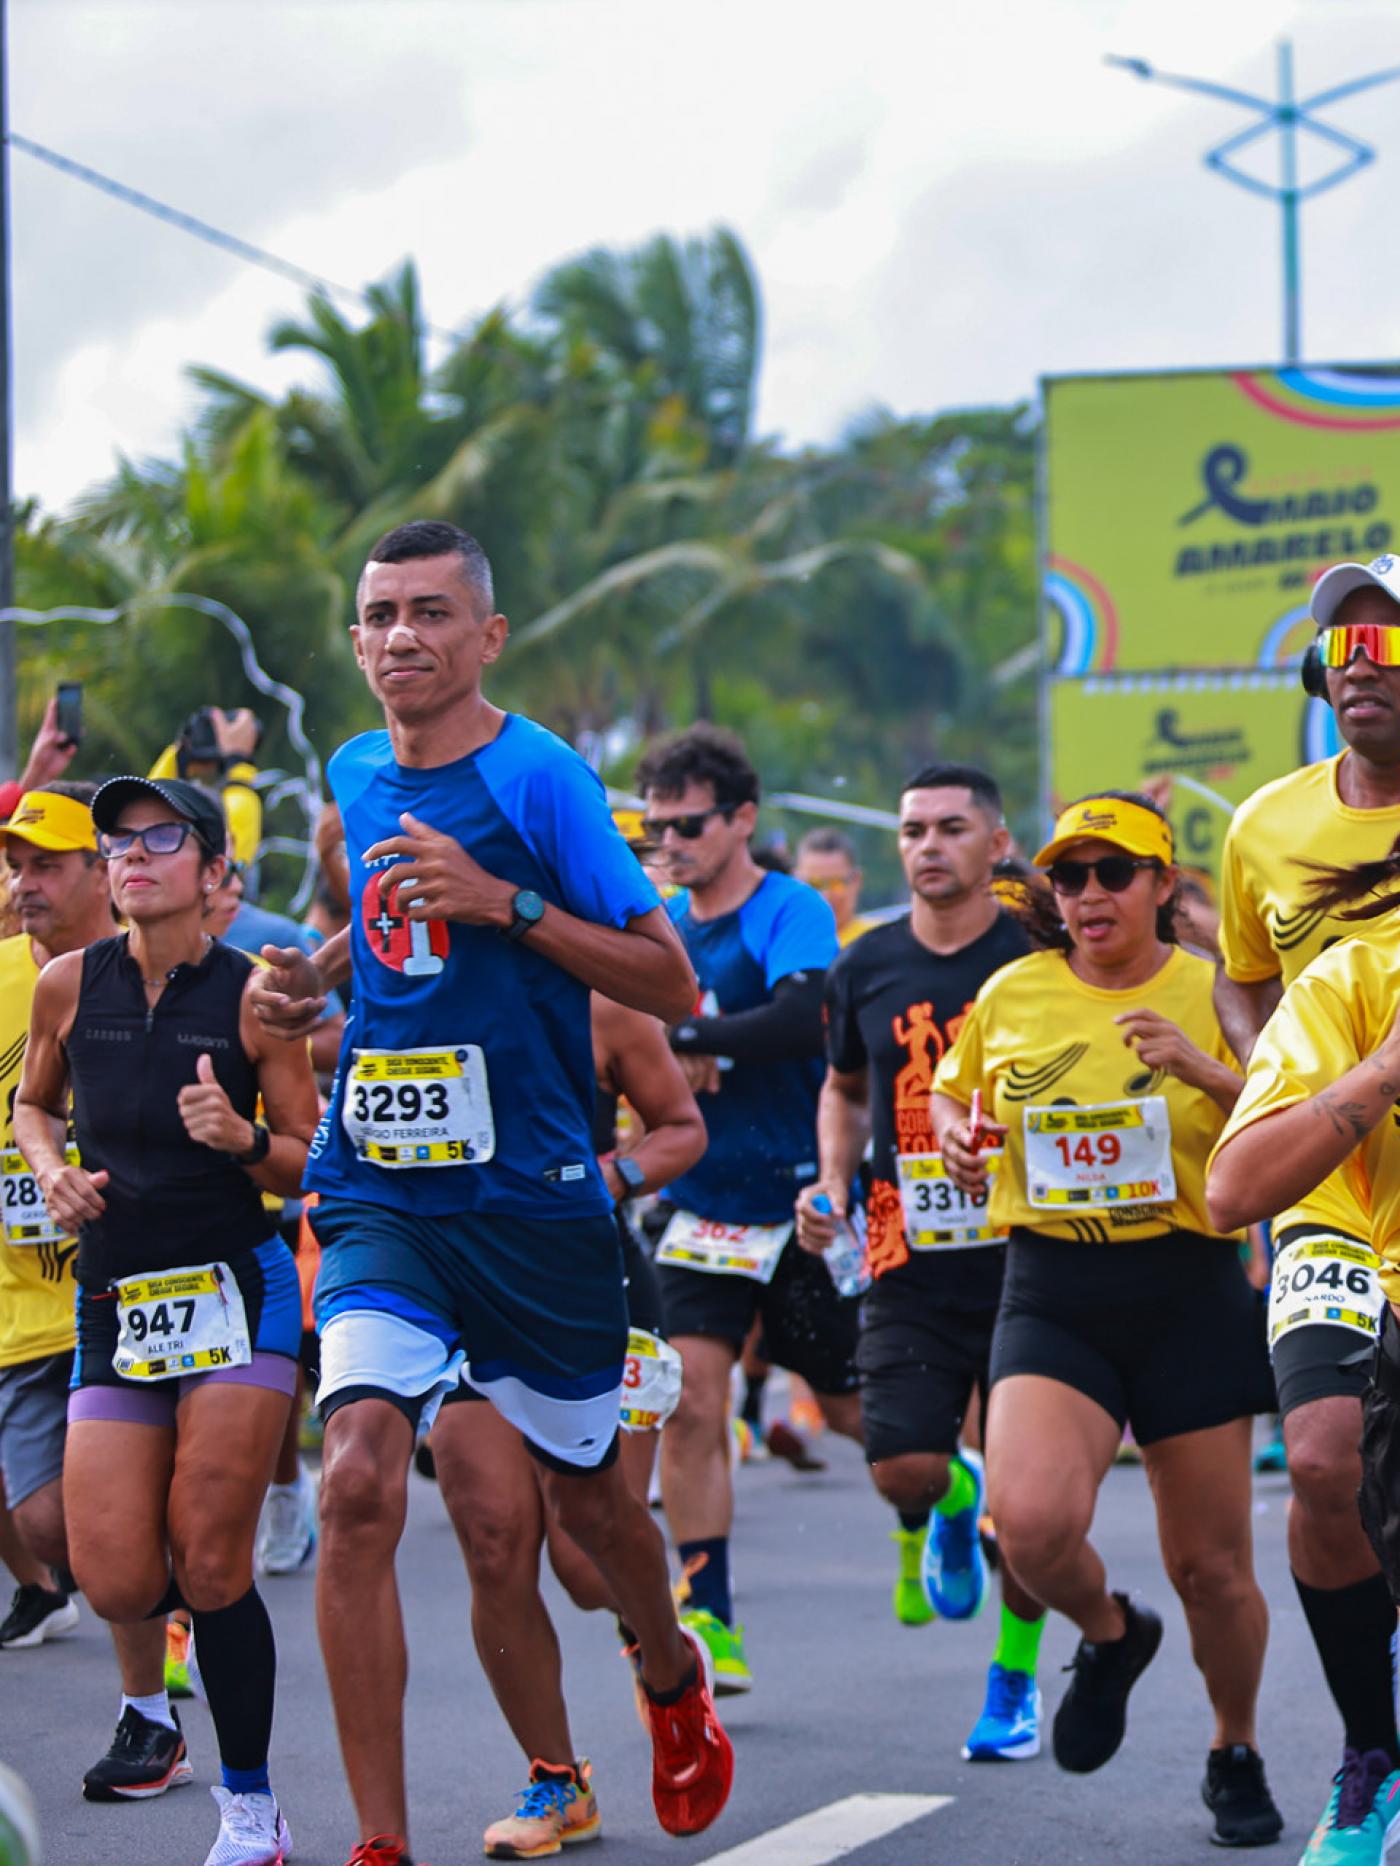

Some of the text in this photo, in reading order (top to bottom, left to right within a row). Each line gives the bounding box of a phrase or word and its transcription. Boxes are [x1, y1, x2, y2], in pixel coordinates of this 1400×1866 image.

[354, 1083, 450, 1122] 3293
[1055, 1132, 1122, 1168] 149
[4, 1177, 46, 1208] 28
[1127, 1180, 1162, 1198] 10K
[1276, 1261, 1371, 1304] 3046
[128, 1299, 196, 1342] 947
[1358, 1311, 1379, 1333] 5K
[208, 1346, 232, 1364] 5K
